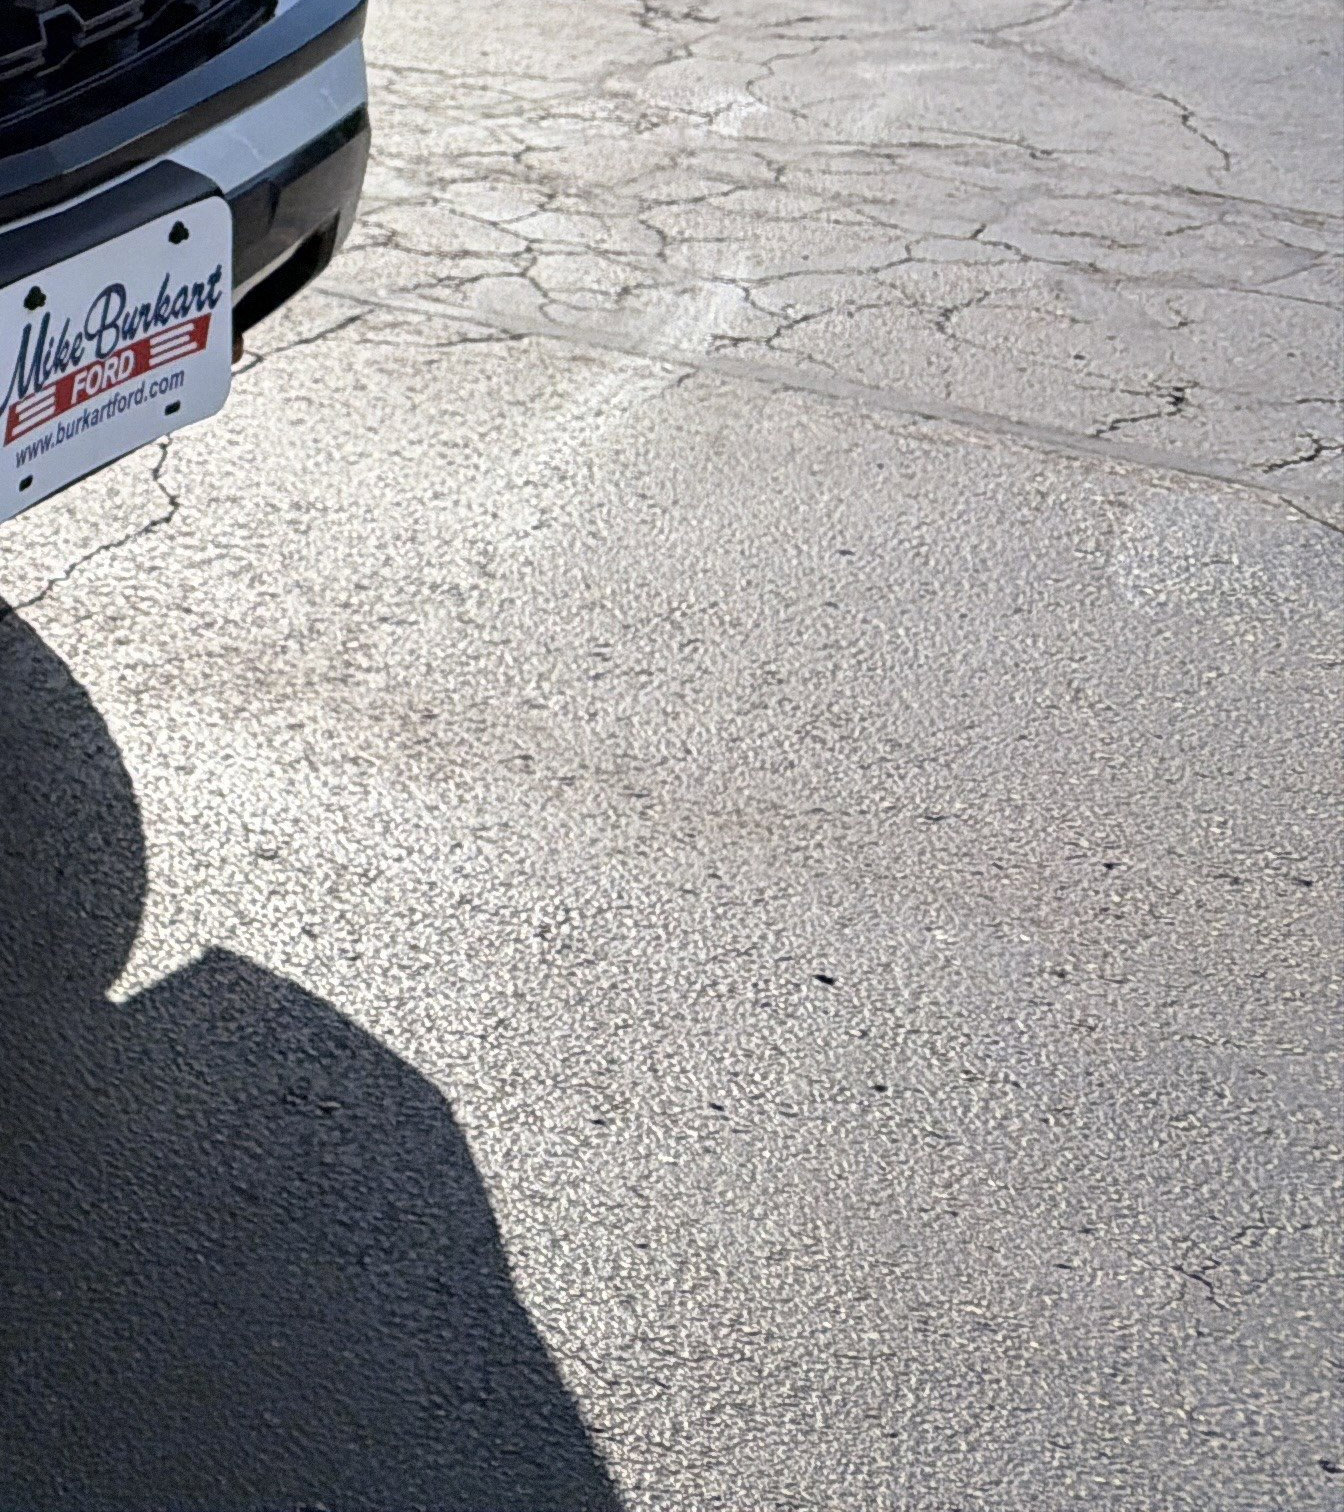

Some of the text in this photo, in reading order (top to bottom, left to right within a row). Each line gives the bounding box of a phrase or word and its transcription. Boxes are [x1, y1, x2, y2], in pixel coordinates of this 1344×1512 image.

[85, 264, 223, 360] Burkart
[14, 368, 186, 469] www.burkartford.com
[69, 349, 137, 405] FORD
